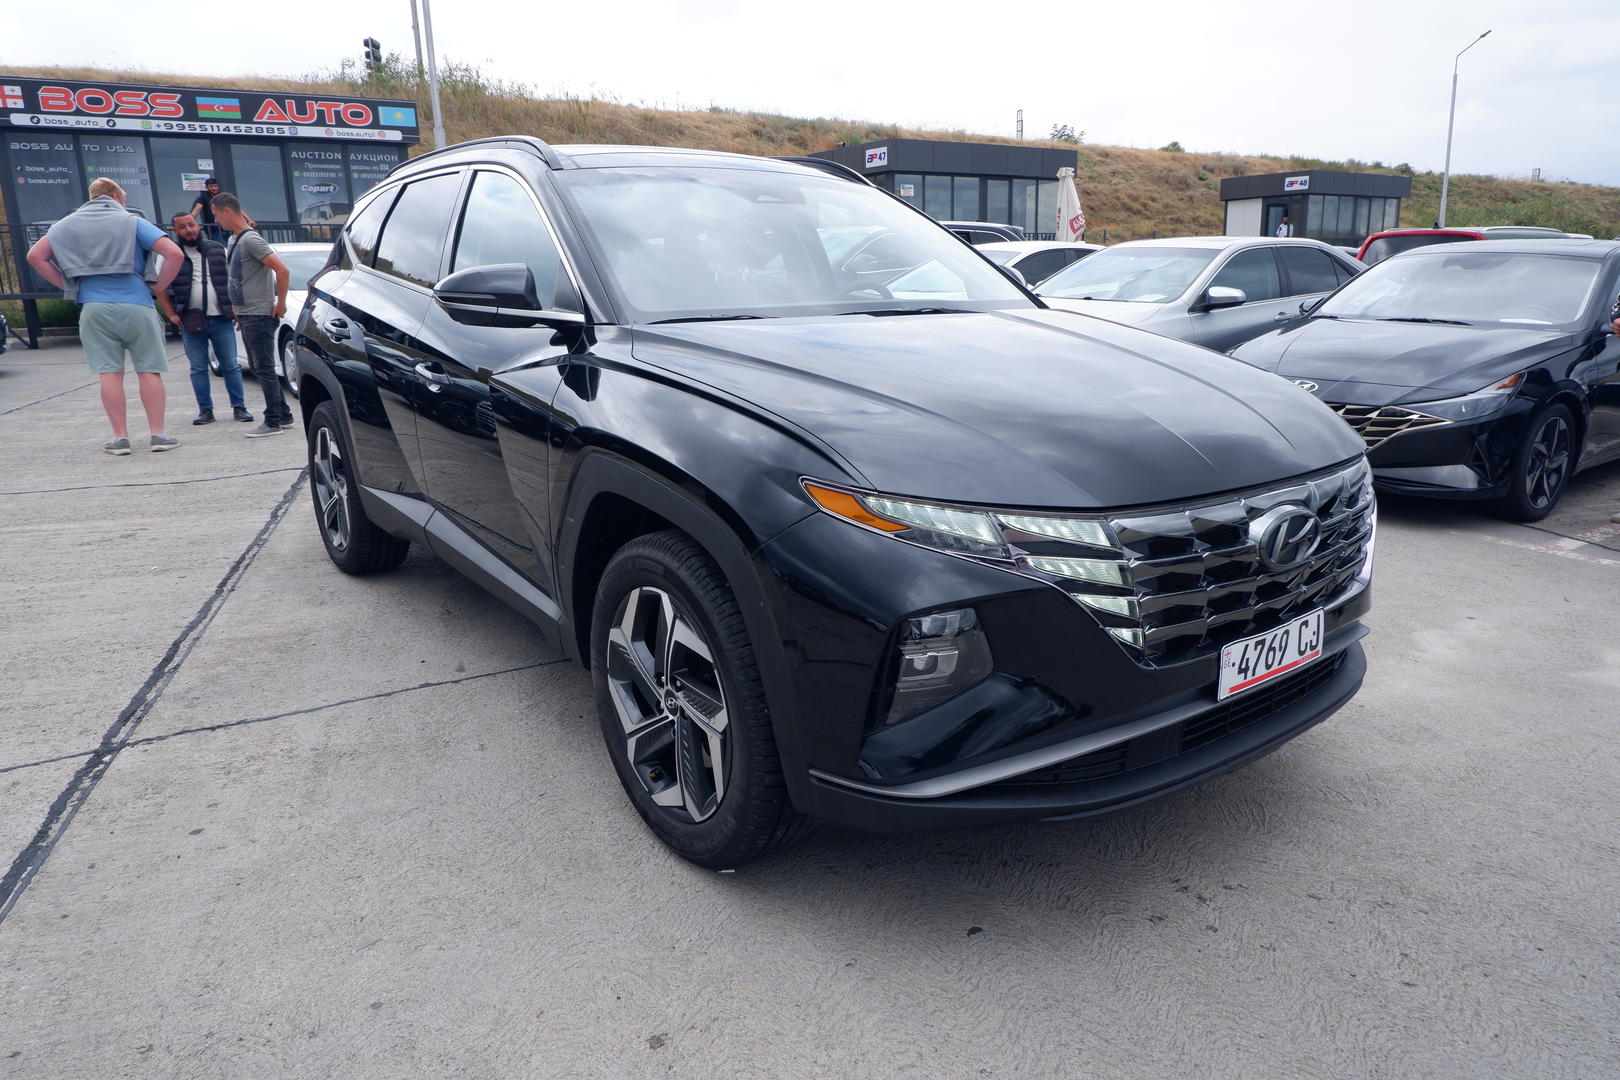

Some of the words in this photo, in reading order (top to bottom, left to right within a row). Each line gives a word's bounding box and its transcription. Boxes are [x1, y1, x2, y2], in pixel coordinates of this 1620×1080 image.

[37, 86, 184, 118] BOSS
[253, 98, 373, 127] AUTO
[155, 122, 286, 135] +995511452885
[10, 142, 50, 150] BOSS
[106, 145, 137, 153] USA
[291, 151, 342, 160] AUCTION
[350, 153, 398, 162] АУКЦИОН
[878, 151, 886, 161] 47
[301, 184, 334, 193] Copart
[1237, 629, 1290, 680] 4769
[1297, 613, 1321, 656] CJ
